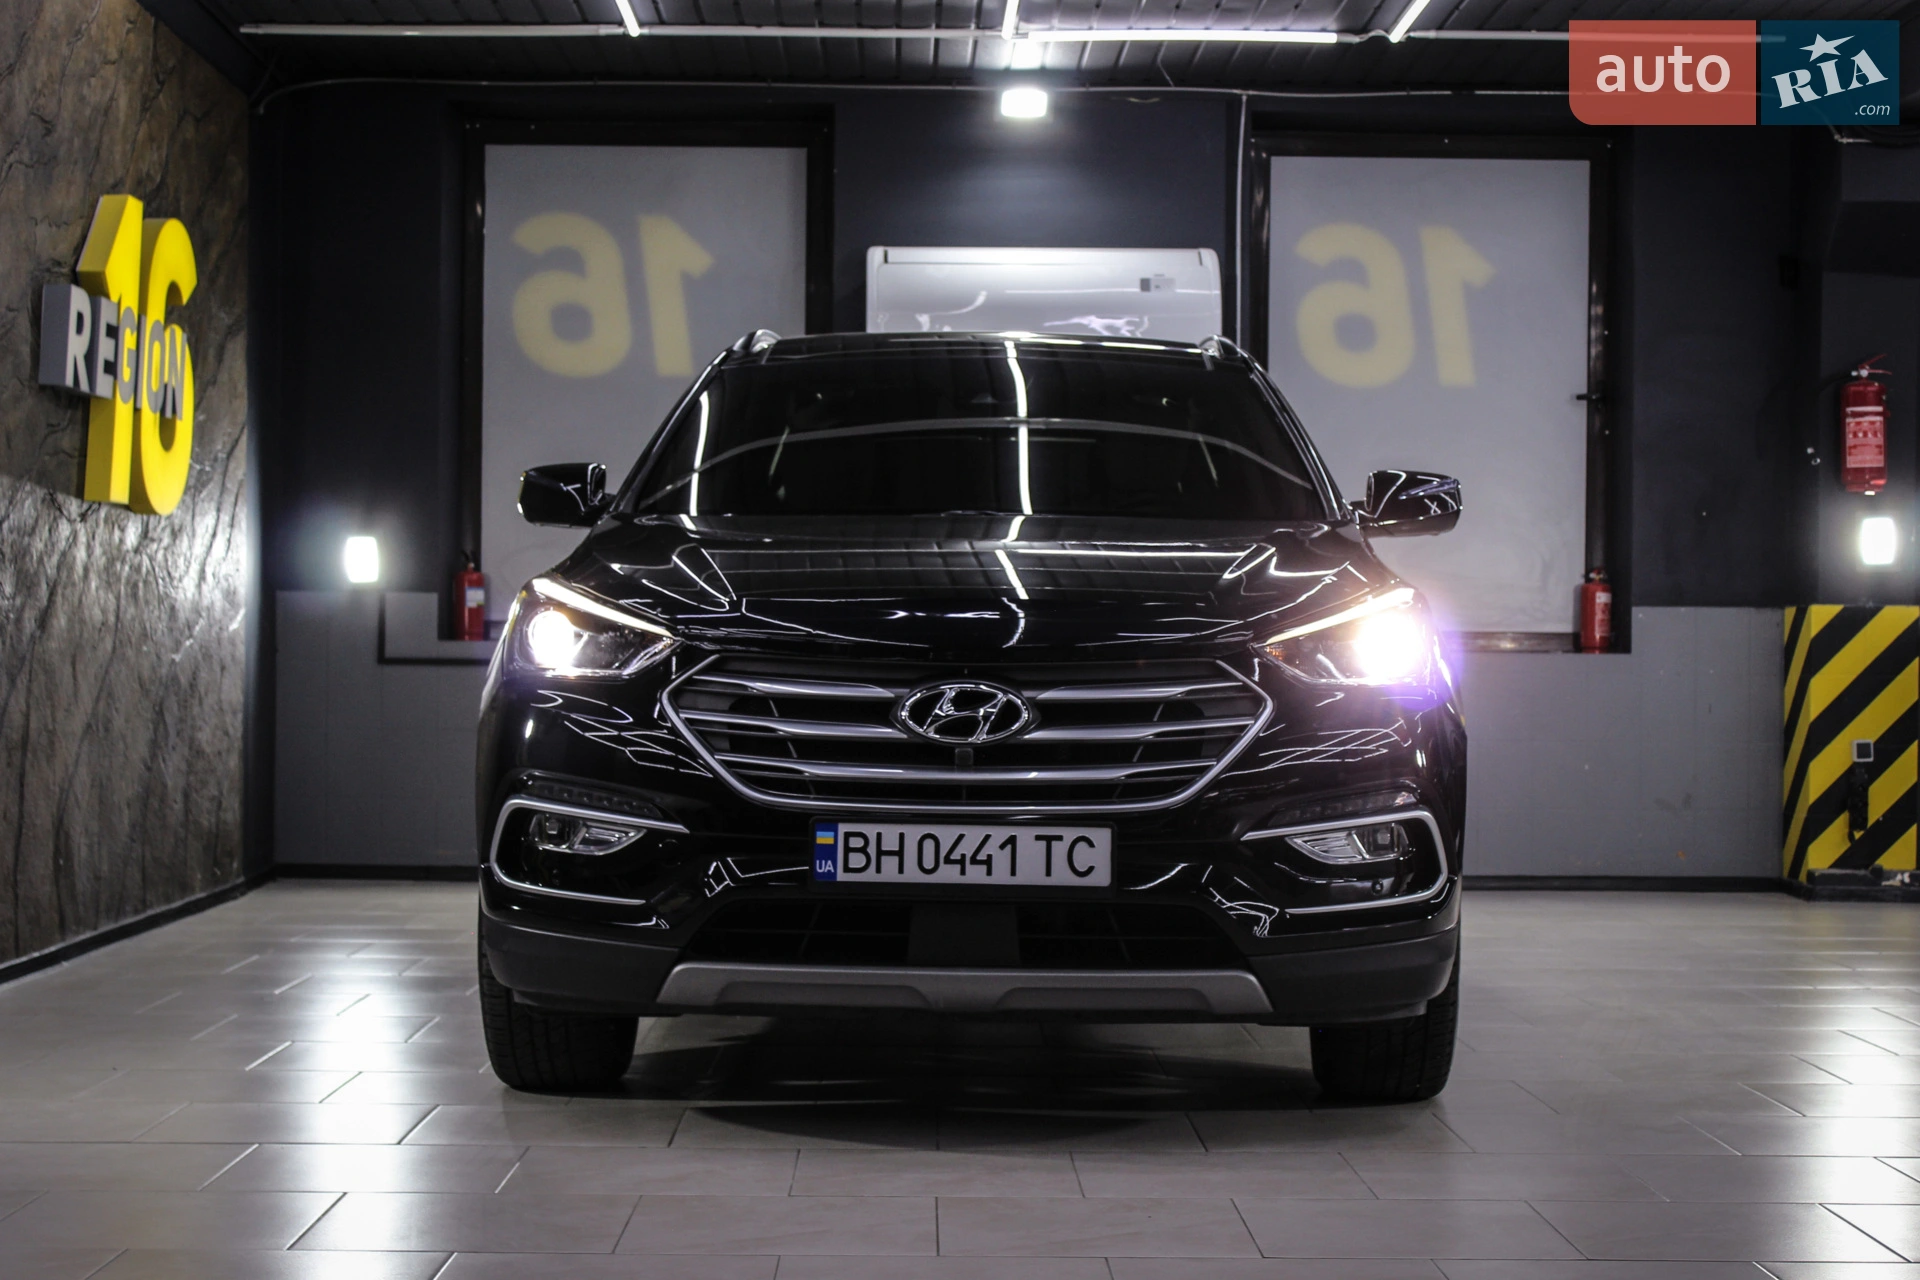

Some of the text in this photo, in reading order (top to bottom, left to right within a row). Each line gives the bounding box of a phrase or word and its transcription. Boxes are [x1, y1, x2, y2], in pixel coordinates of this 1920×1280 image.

[66, 284, 187, 421] REGION
[92, 194, 197, 516] 16
[816, 860, 834, 873] UA
[842, 831, 1096, 878] BH 0441 TC
